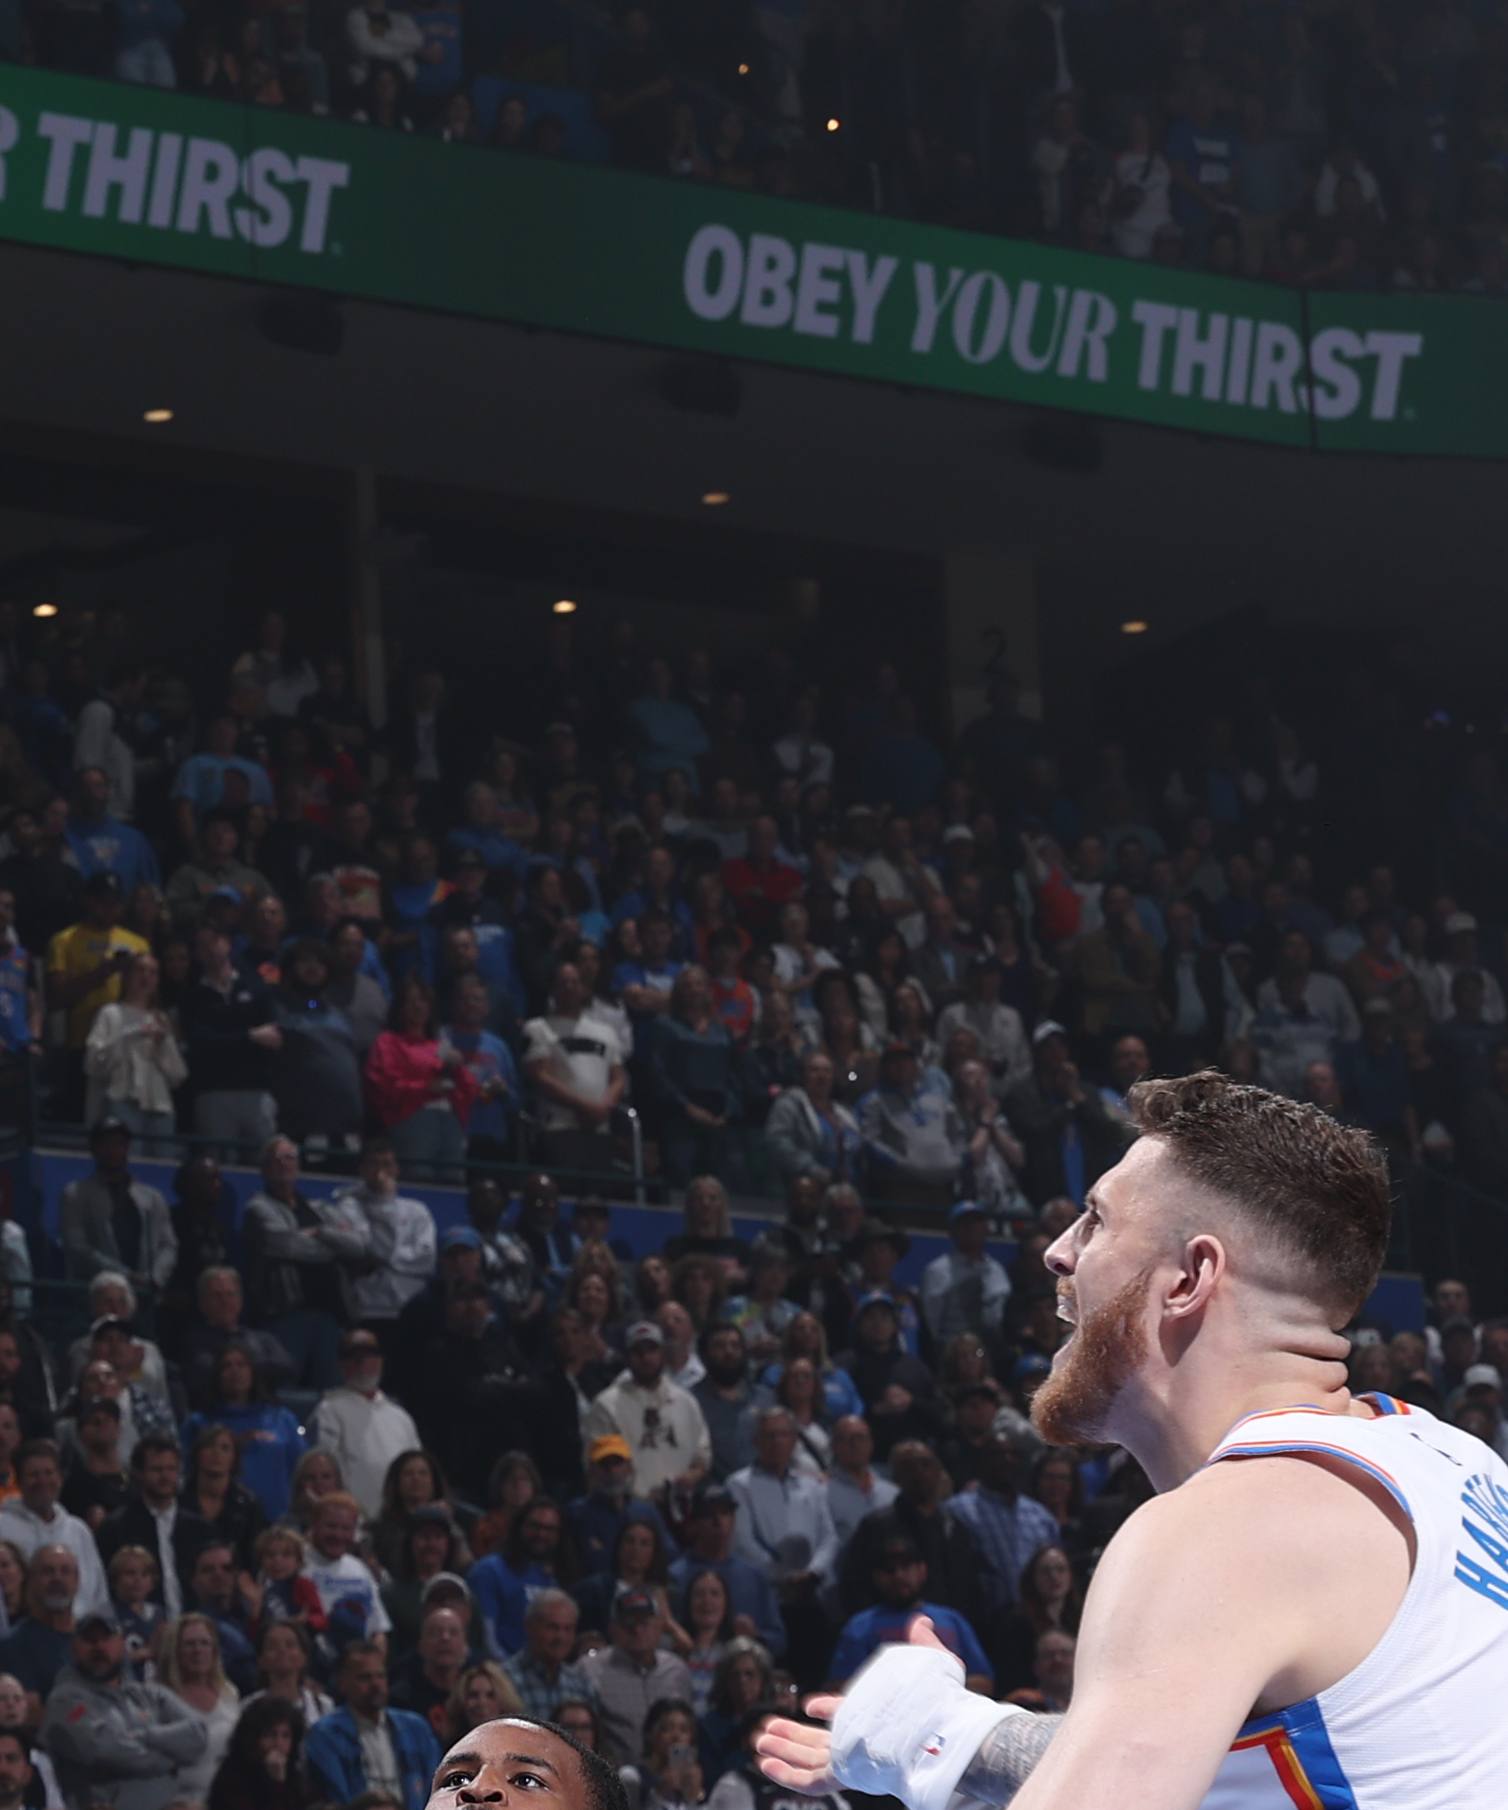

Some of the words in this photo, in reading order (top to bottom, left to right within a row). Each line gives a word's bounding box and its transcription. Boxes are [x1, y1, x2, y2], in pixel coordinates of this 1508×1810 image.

[37, 112, 350, 255] THIRST
[683, 225, 898, 345] OBEY
[910, 262, 1117, 383] YOUR
[1133, 300, 1423, 422] THIRST
